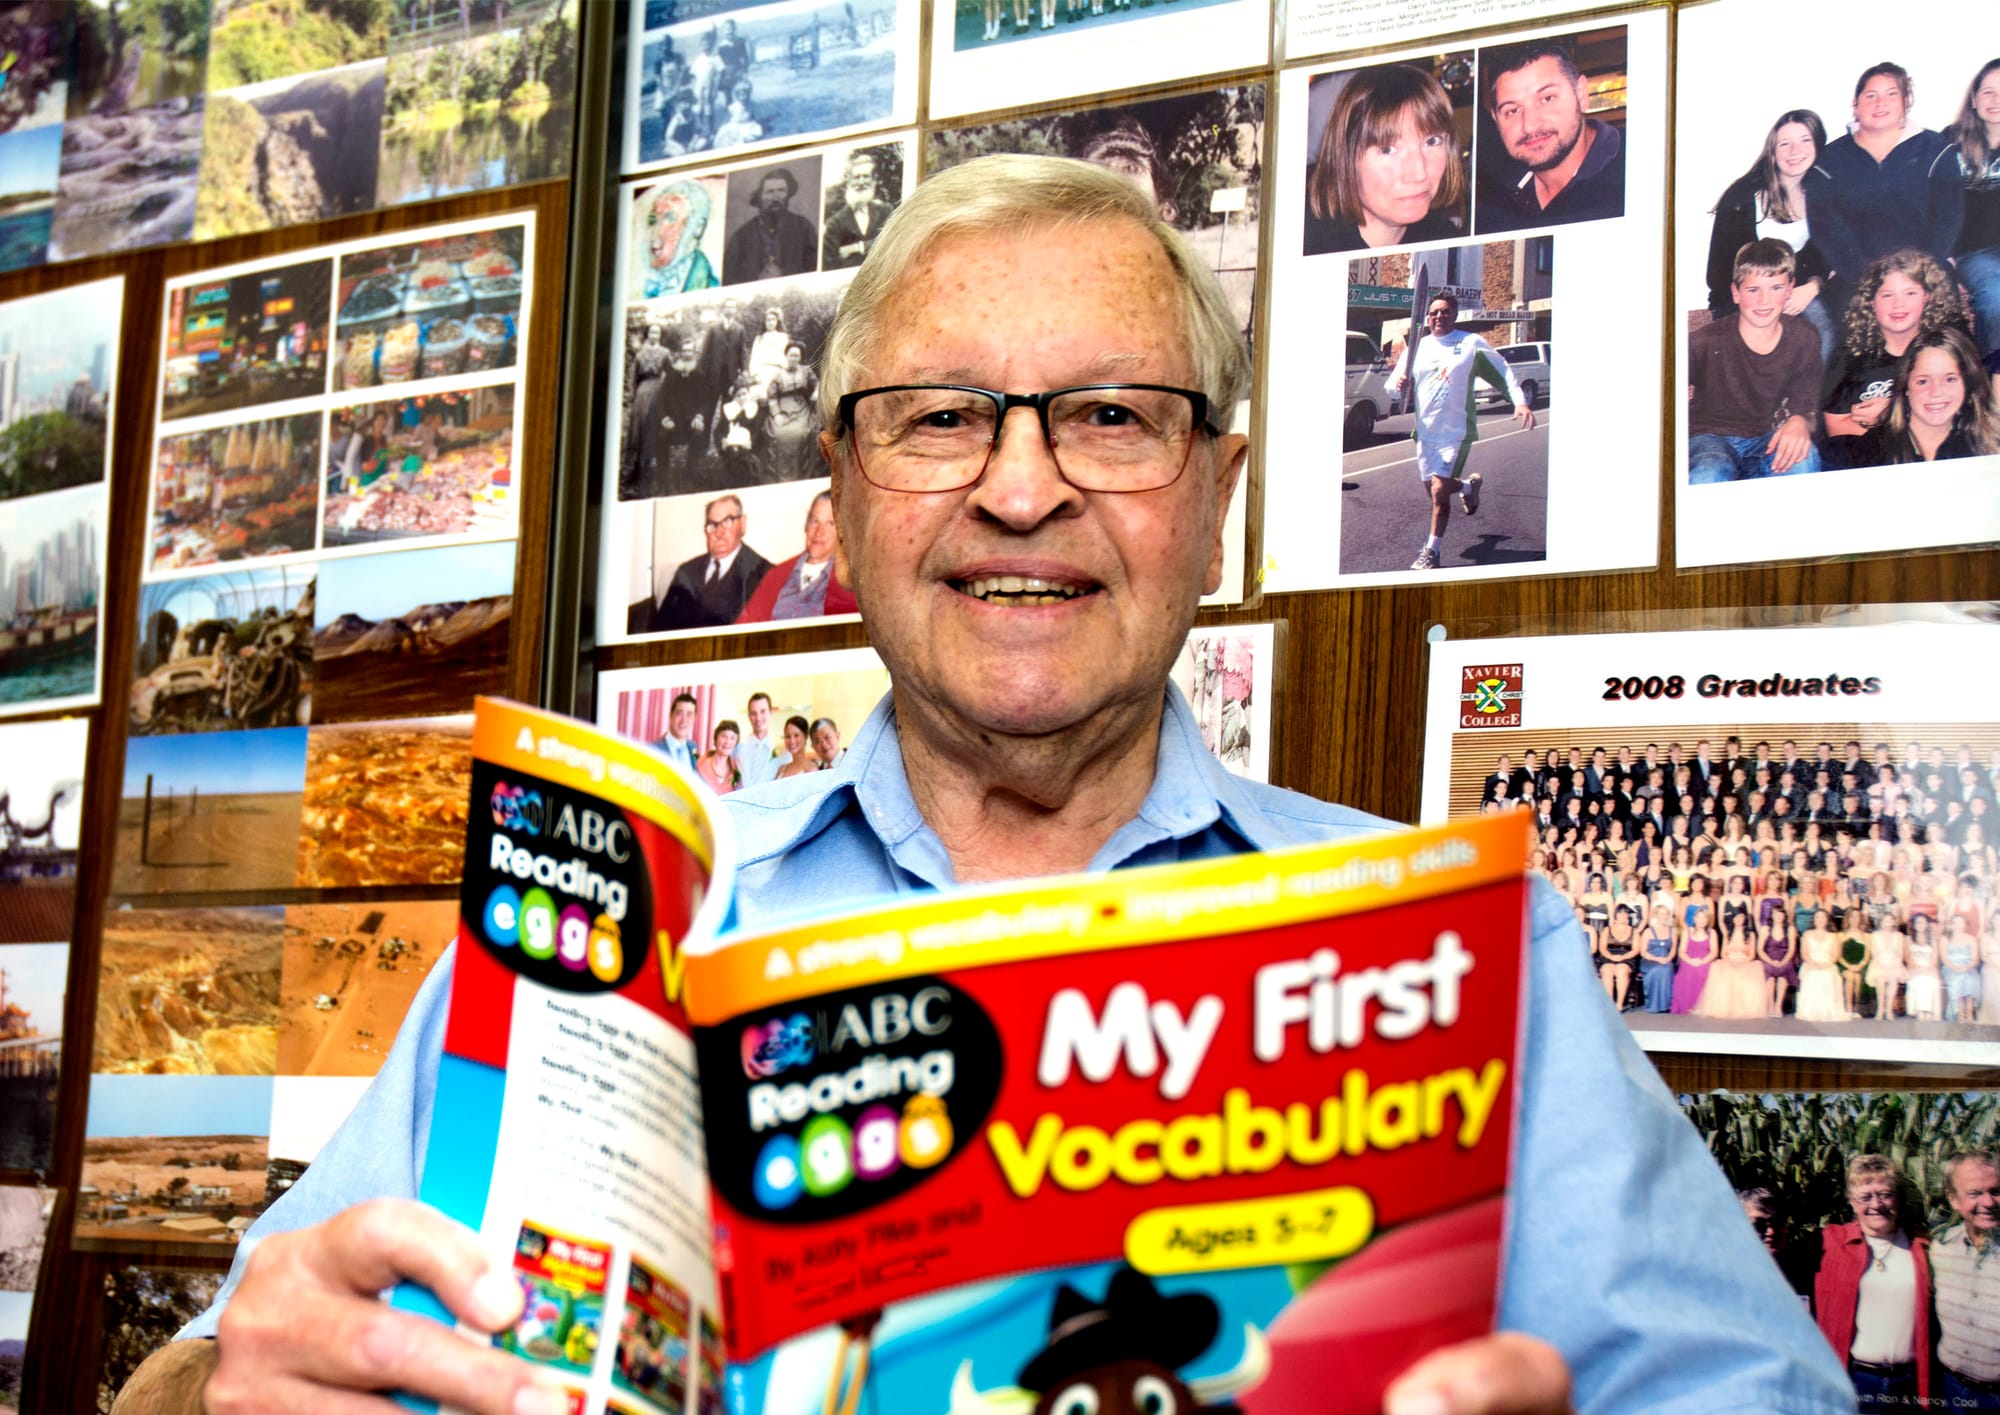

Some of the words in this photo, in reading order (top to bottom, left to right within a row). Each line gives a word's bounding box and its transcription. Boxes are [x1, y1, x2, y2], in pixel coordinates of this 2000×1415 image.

[1363, 292, 1397, 302] JUST
[1455, 287, 1482, 300] BAKERY
[1463, 665, 1522, 680] XAVIER
[1602, 674, 1686, 702] 2008
[1696, 671, 1883, 699] Graduates
[1461, 713, 1521, 727] COLLEGE
[515, 726, 536, 755] A
[552, 802, 632, 865] ABC
[489, 832, 629, 922] Reading
[490, 899, 620, 972] eggs
[763, 945, 794, 982] A
[830, 985, 954, 1053] ABC
[1038, 980, 1225, 1100] My
[1252, 930, 1476, 1063] First
[747, 1048, 956, 1134] Reading
[986, 1057, 1507, 1199] Vocabulary
[760, 1112, 945, 1194] eggs
[1165, 1225, 1258, 1257] Ages
[1876, 1393, 1899, 1404] Ron
[1900, 1394, 1911, 1405] &
